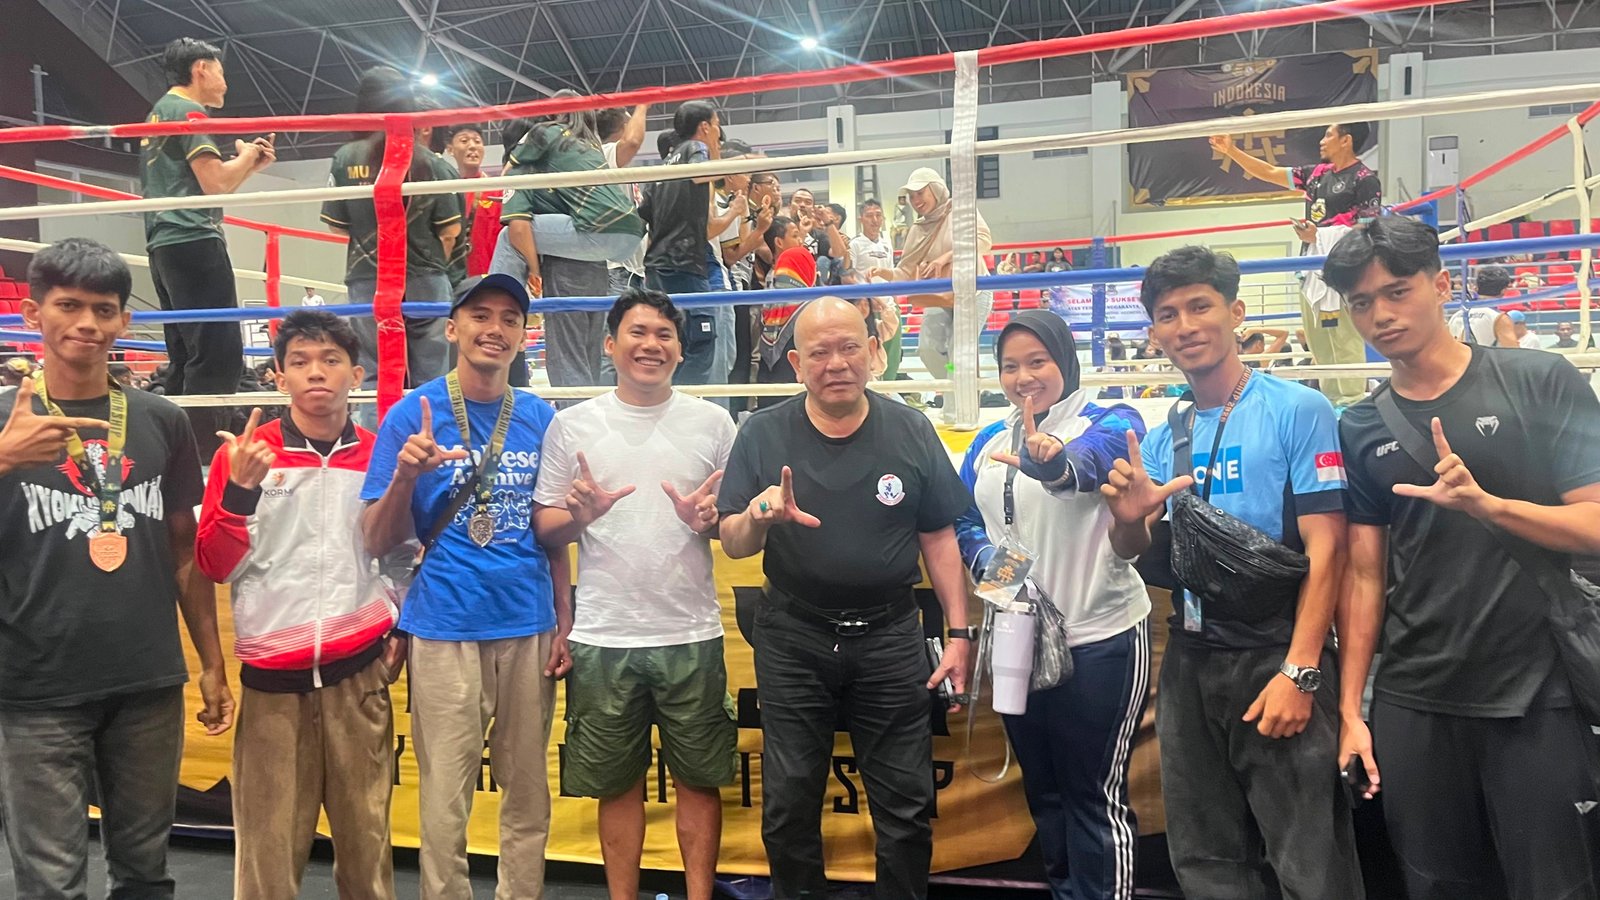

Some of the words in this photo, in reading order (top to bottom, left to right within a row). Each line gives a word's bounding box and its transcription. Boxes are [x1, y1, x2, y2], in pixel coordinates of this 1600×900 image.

[1213, 82, 1286, 108] INDONESIA
[1376, 440, 1400, 457] UFC
[1193, 459, 1239, 485] ONE
